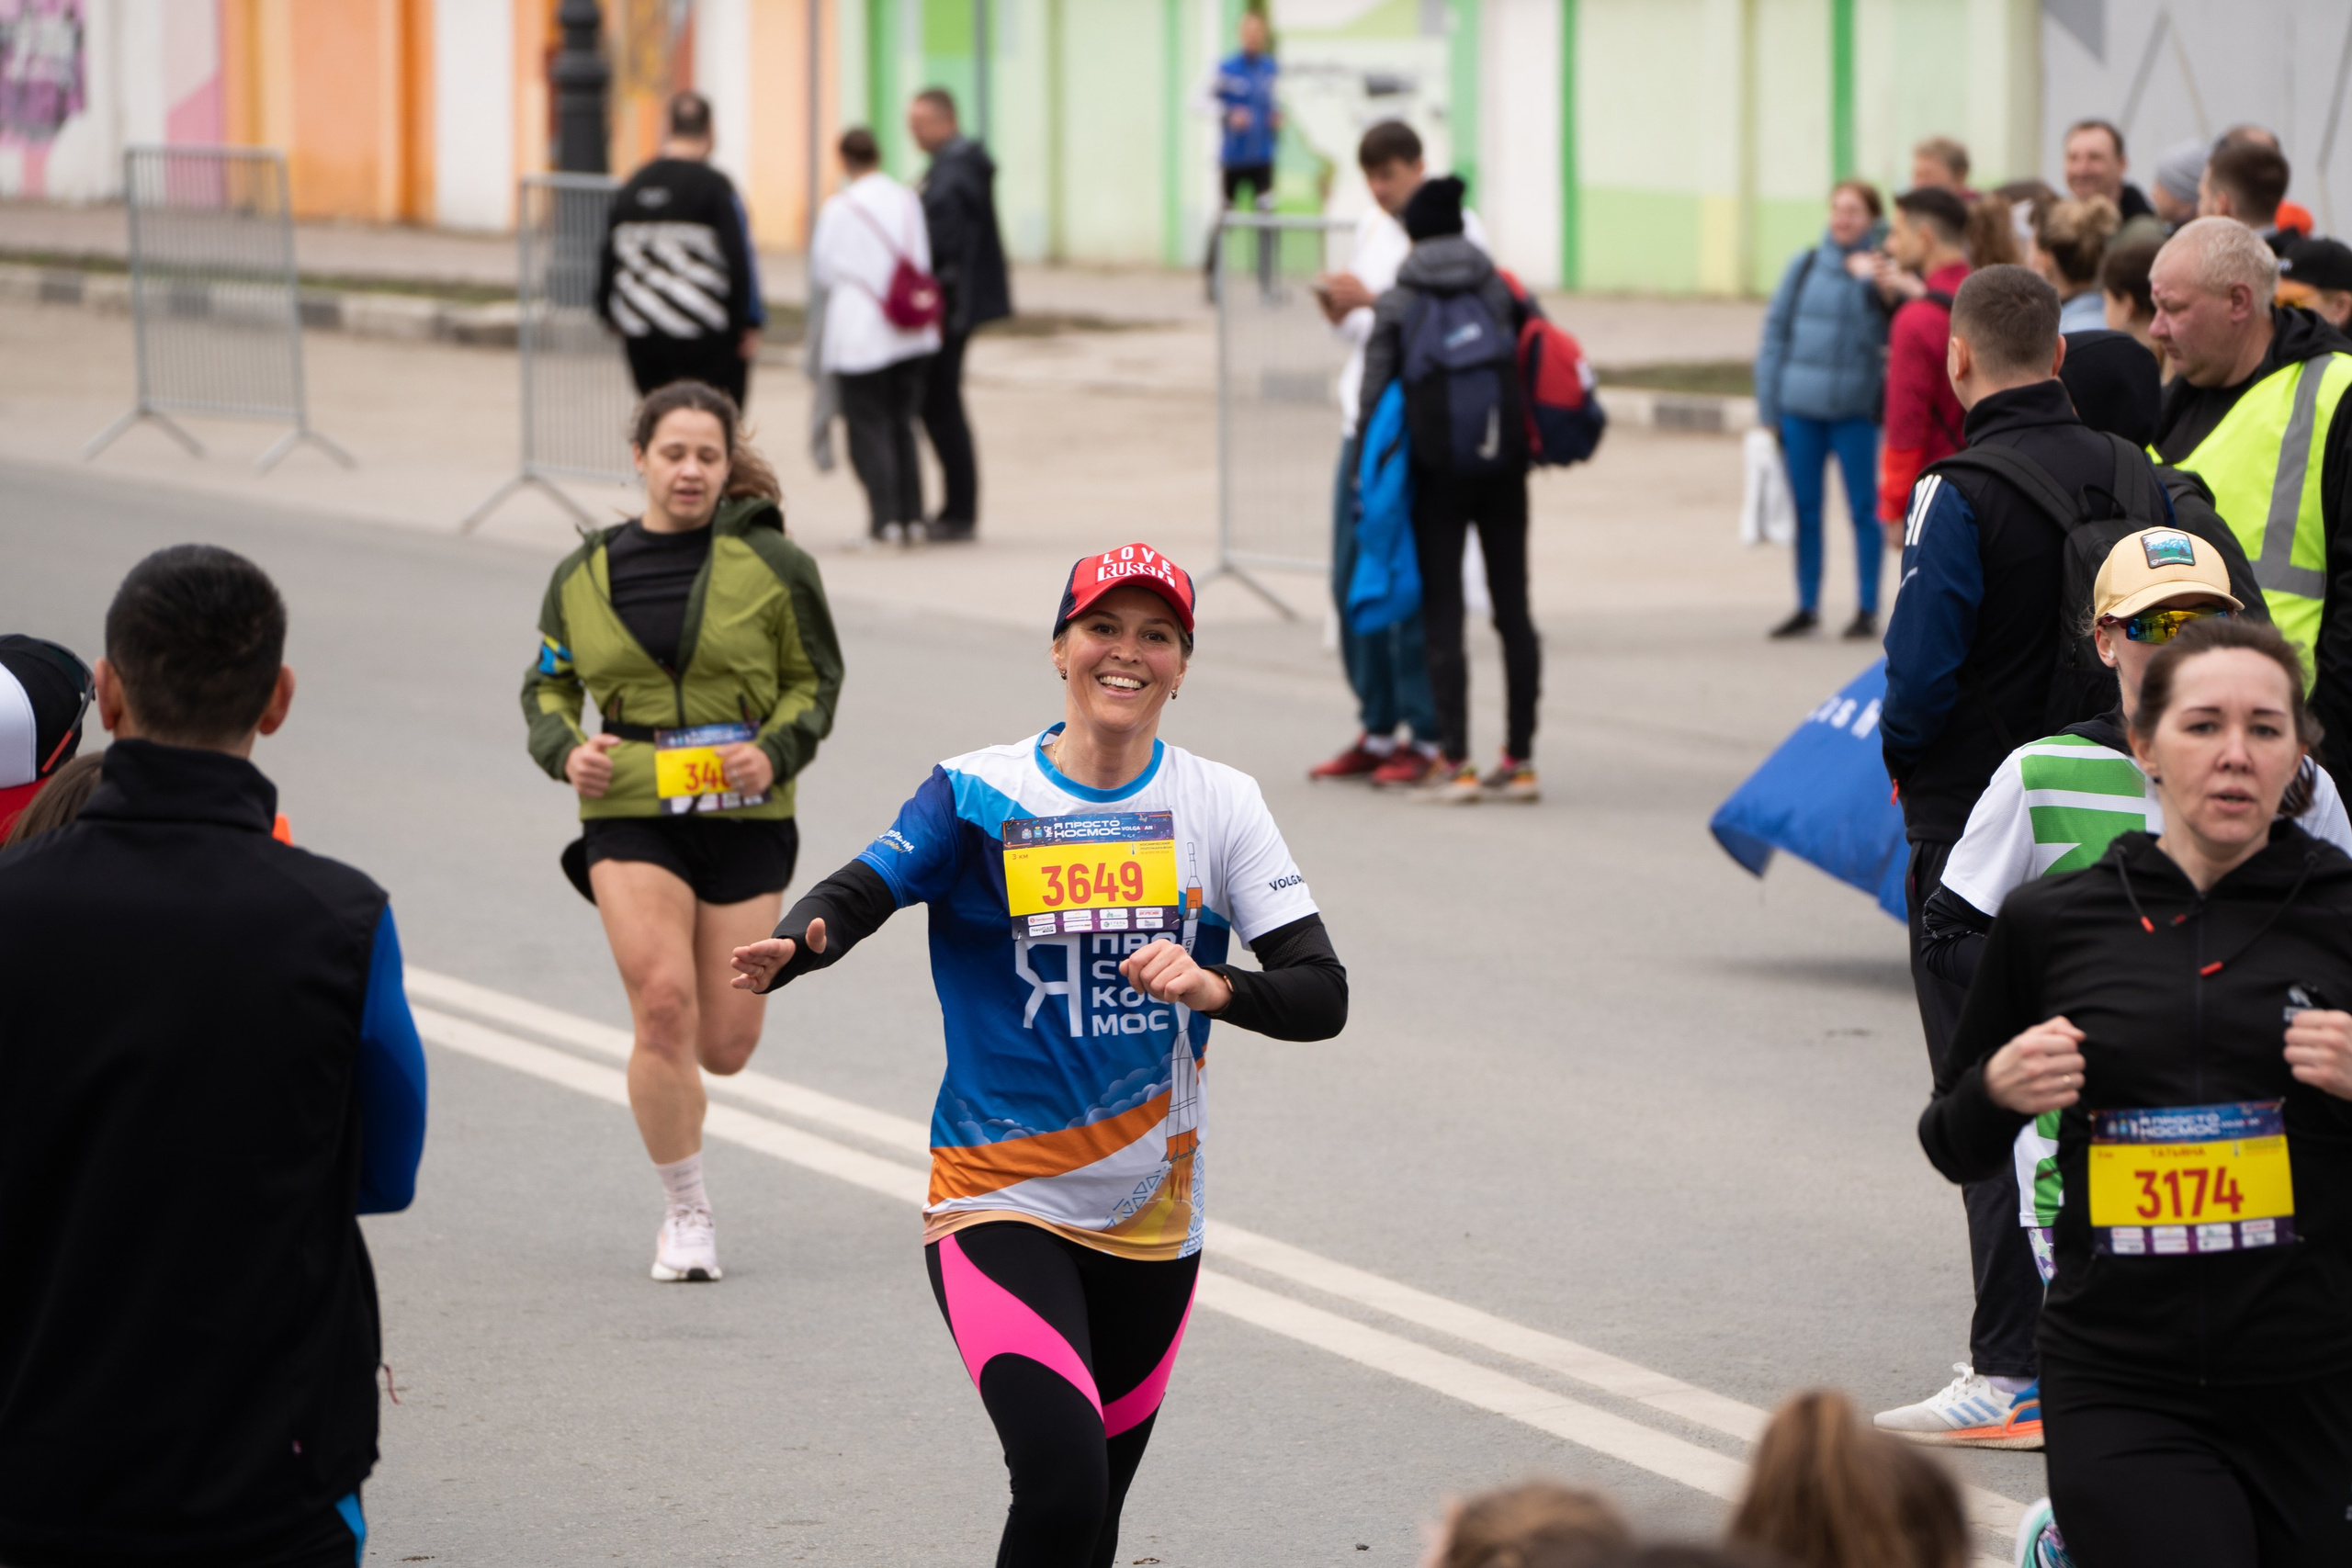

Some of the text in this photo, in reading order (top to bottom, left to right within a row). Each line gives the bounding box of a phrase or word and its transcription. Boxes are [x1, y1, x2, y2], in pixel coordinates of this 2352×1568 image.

[1102, 546, 1171, 576] LOVE
[1054, 827, 1122, 838] КОСМОС
[1065, 820, 1120, 829] ПРОСТО
[1041, 861, 1144, 907] 3649
[1015, 933, 1083, 1038] Я
[1092, 1010, 1170, 1037] МОС
[2134, 1167, 2244, 1219] 3174
